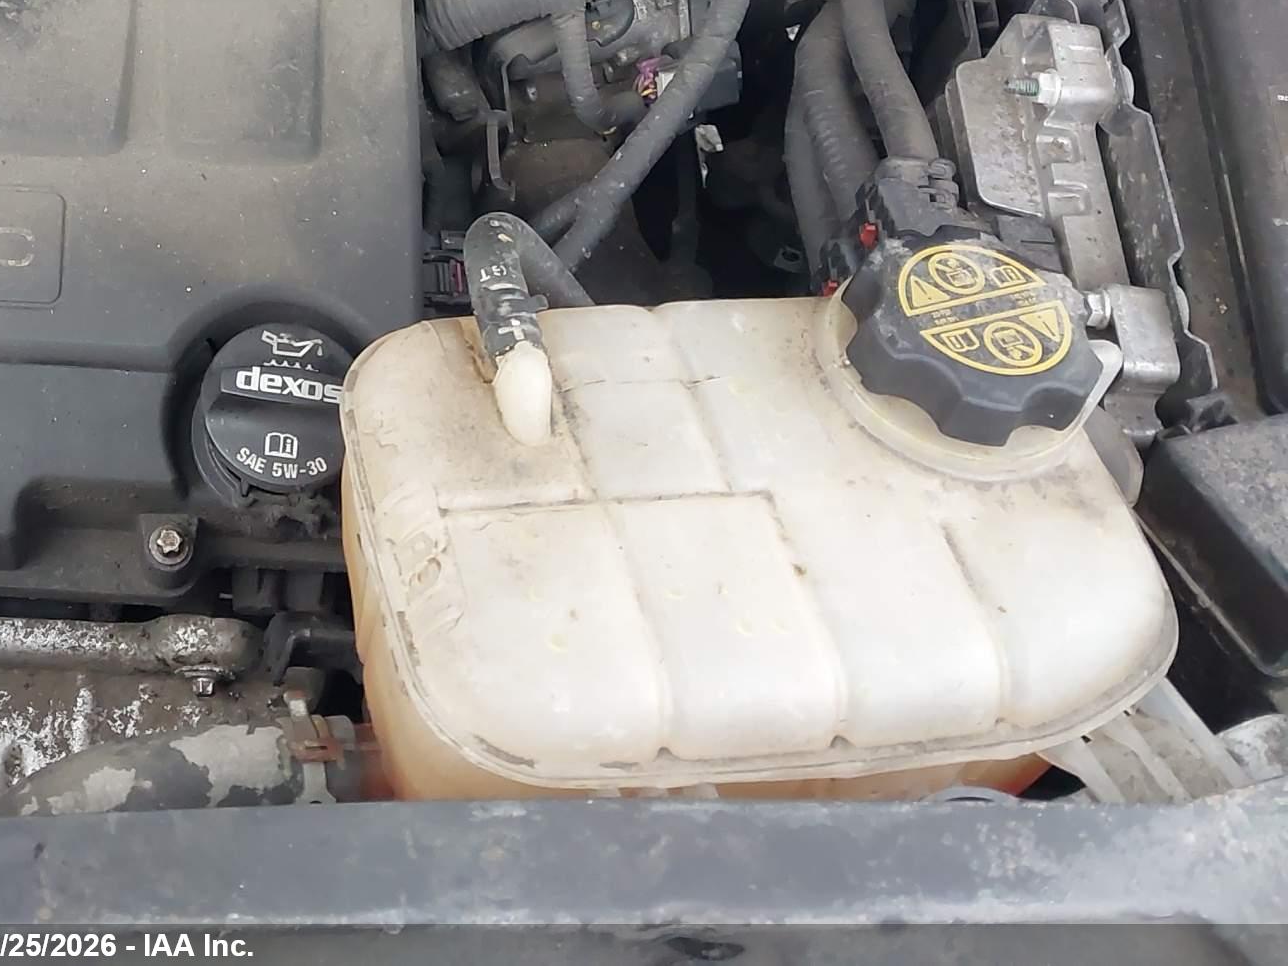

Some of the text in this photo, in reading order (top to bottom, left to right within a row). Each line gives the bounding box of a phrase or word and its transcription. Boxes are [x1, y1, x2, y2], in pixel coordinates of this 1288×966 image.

[236, 366, 344, 404] dexos
[236, 447, 327, 479] SAE 5W-30
